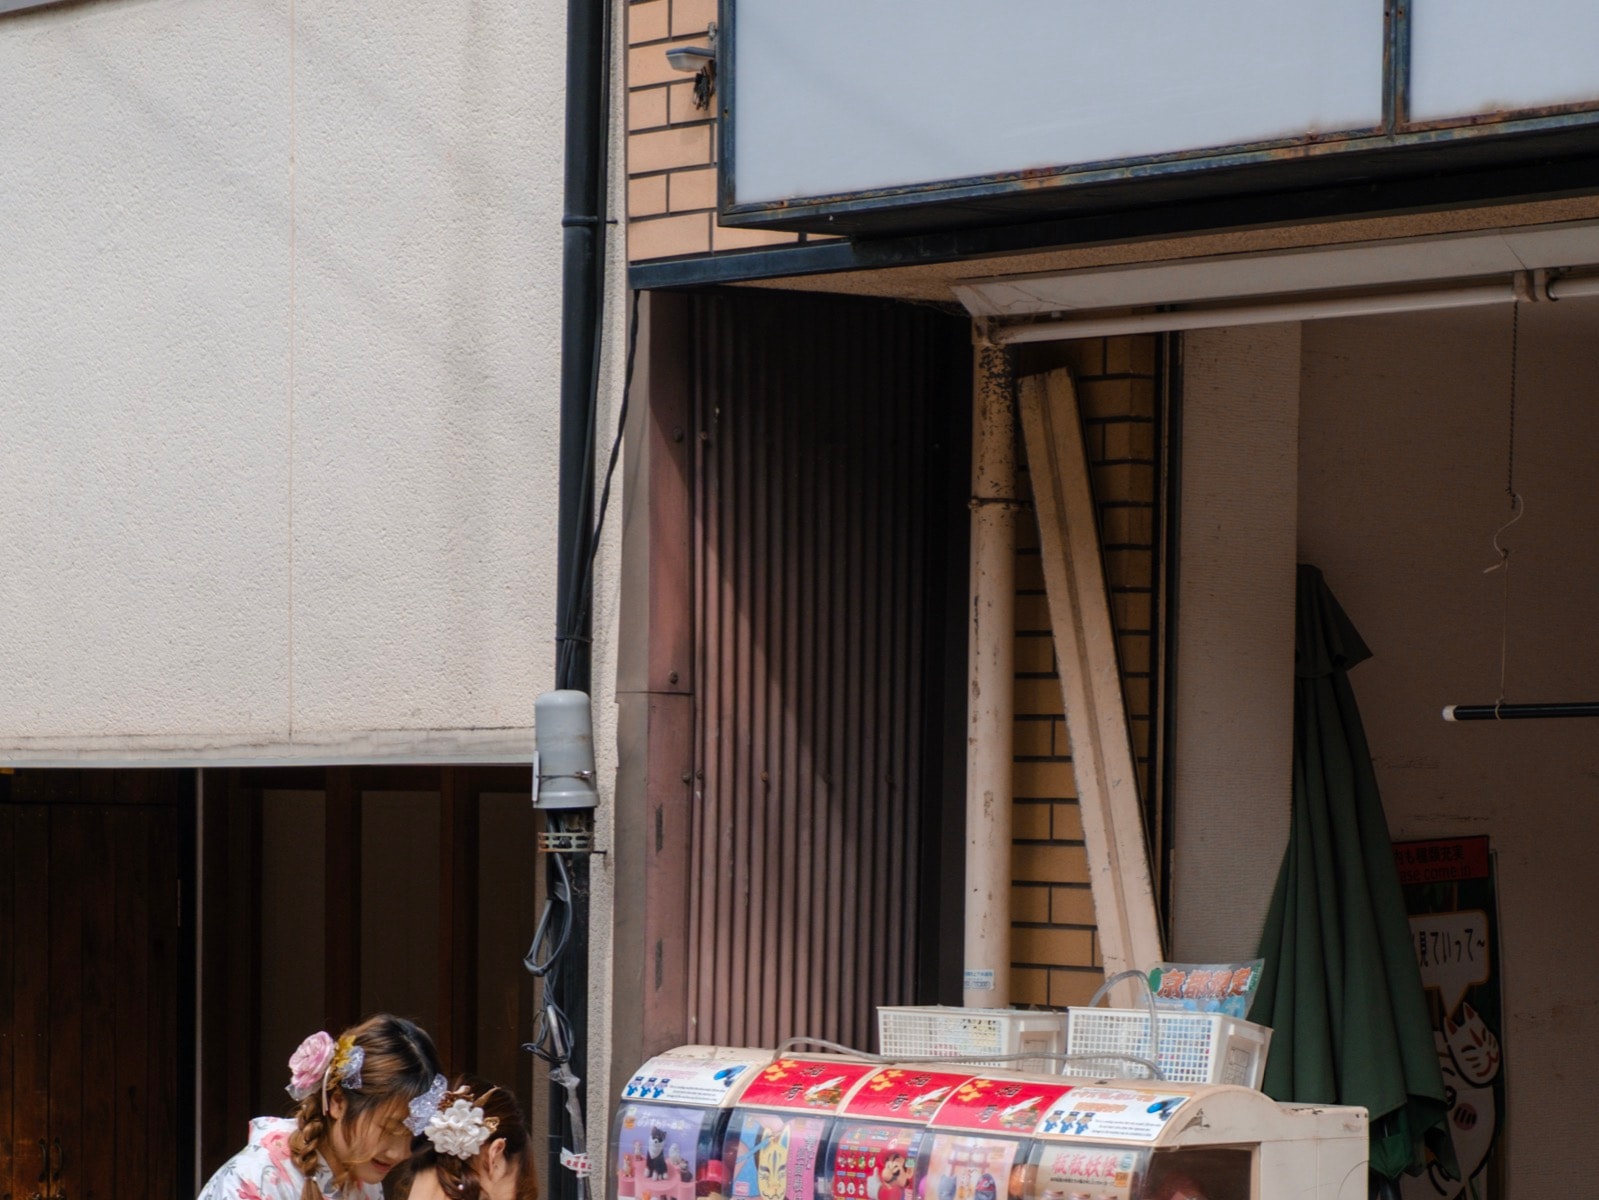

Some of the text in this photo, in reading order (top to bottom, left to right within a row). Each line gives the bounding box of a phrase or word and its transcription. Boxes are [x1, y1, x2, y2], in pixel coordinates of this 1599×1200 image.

[1400, 864, 1472, 882] ase come in
